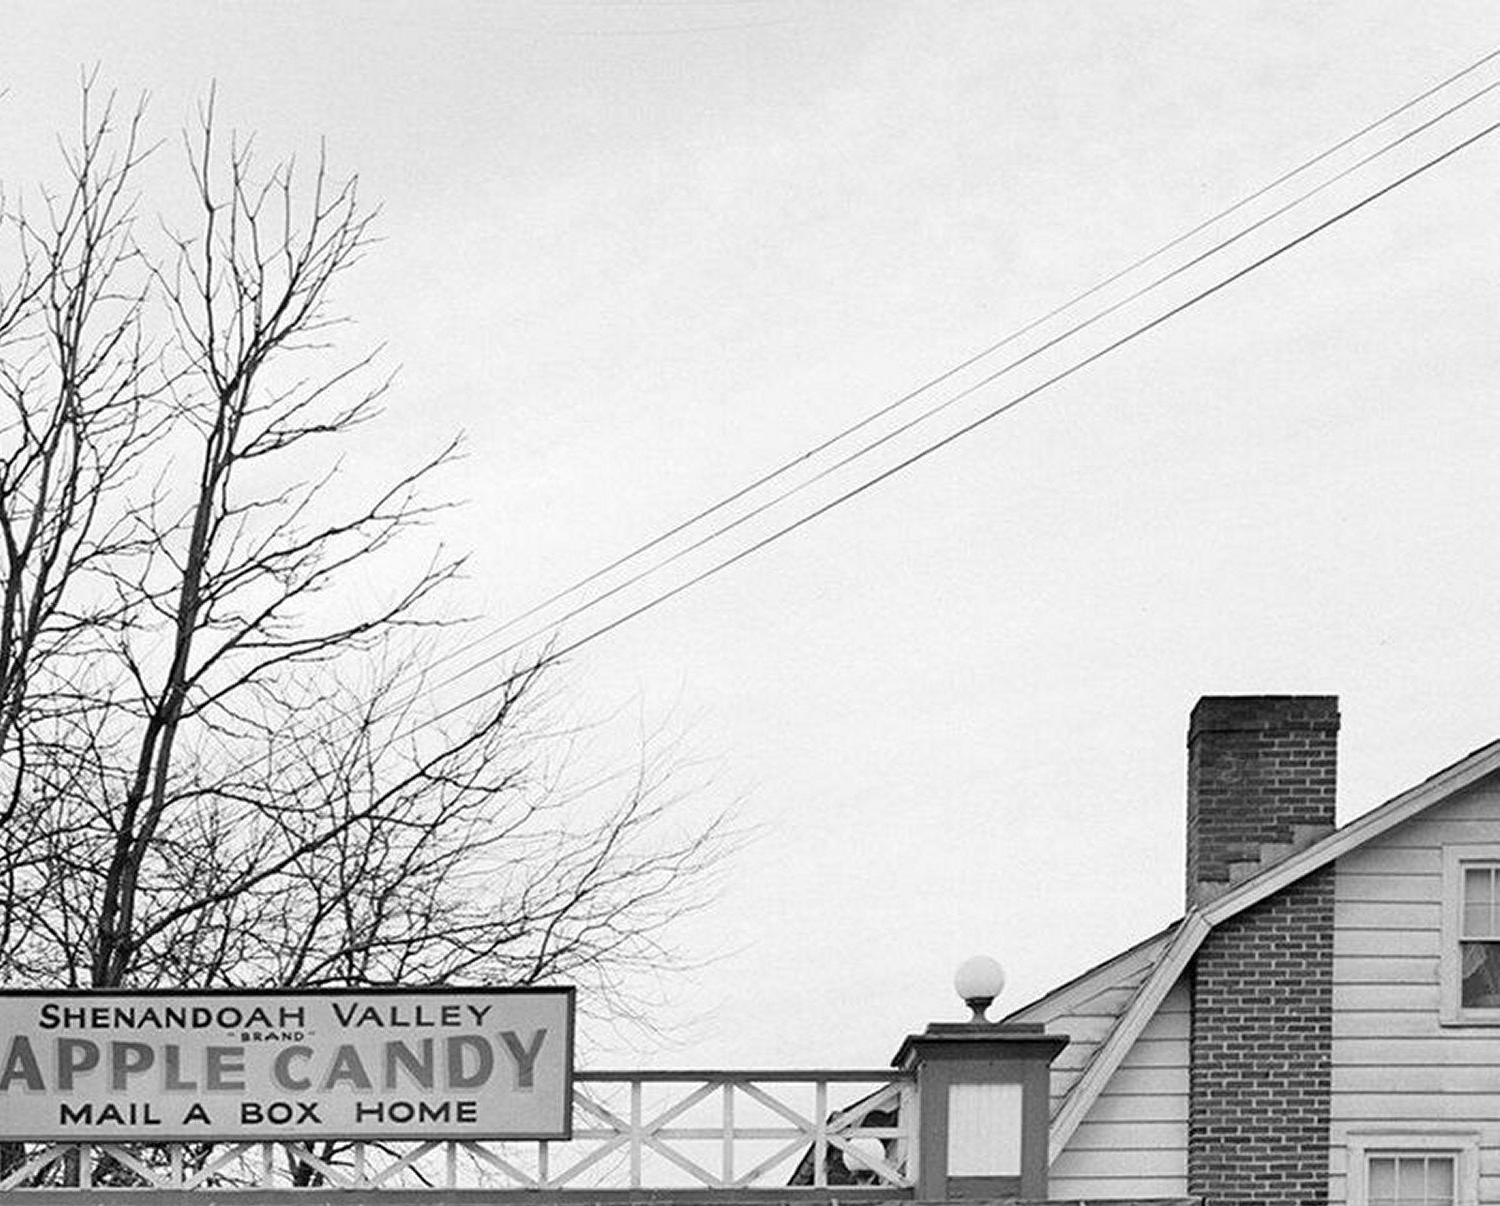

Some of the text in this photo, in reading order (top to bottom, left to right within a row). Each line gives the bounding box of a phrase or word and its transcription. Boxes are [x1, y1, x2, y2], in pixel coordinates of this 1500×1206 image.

[39, 1003, 493, 1029] SHENANDOAH VALLEY
[269, 1028, 548, 1092] CANDY
[59, 1101, 478, 1125] MAIL A BOX HOME
